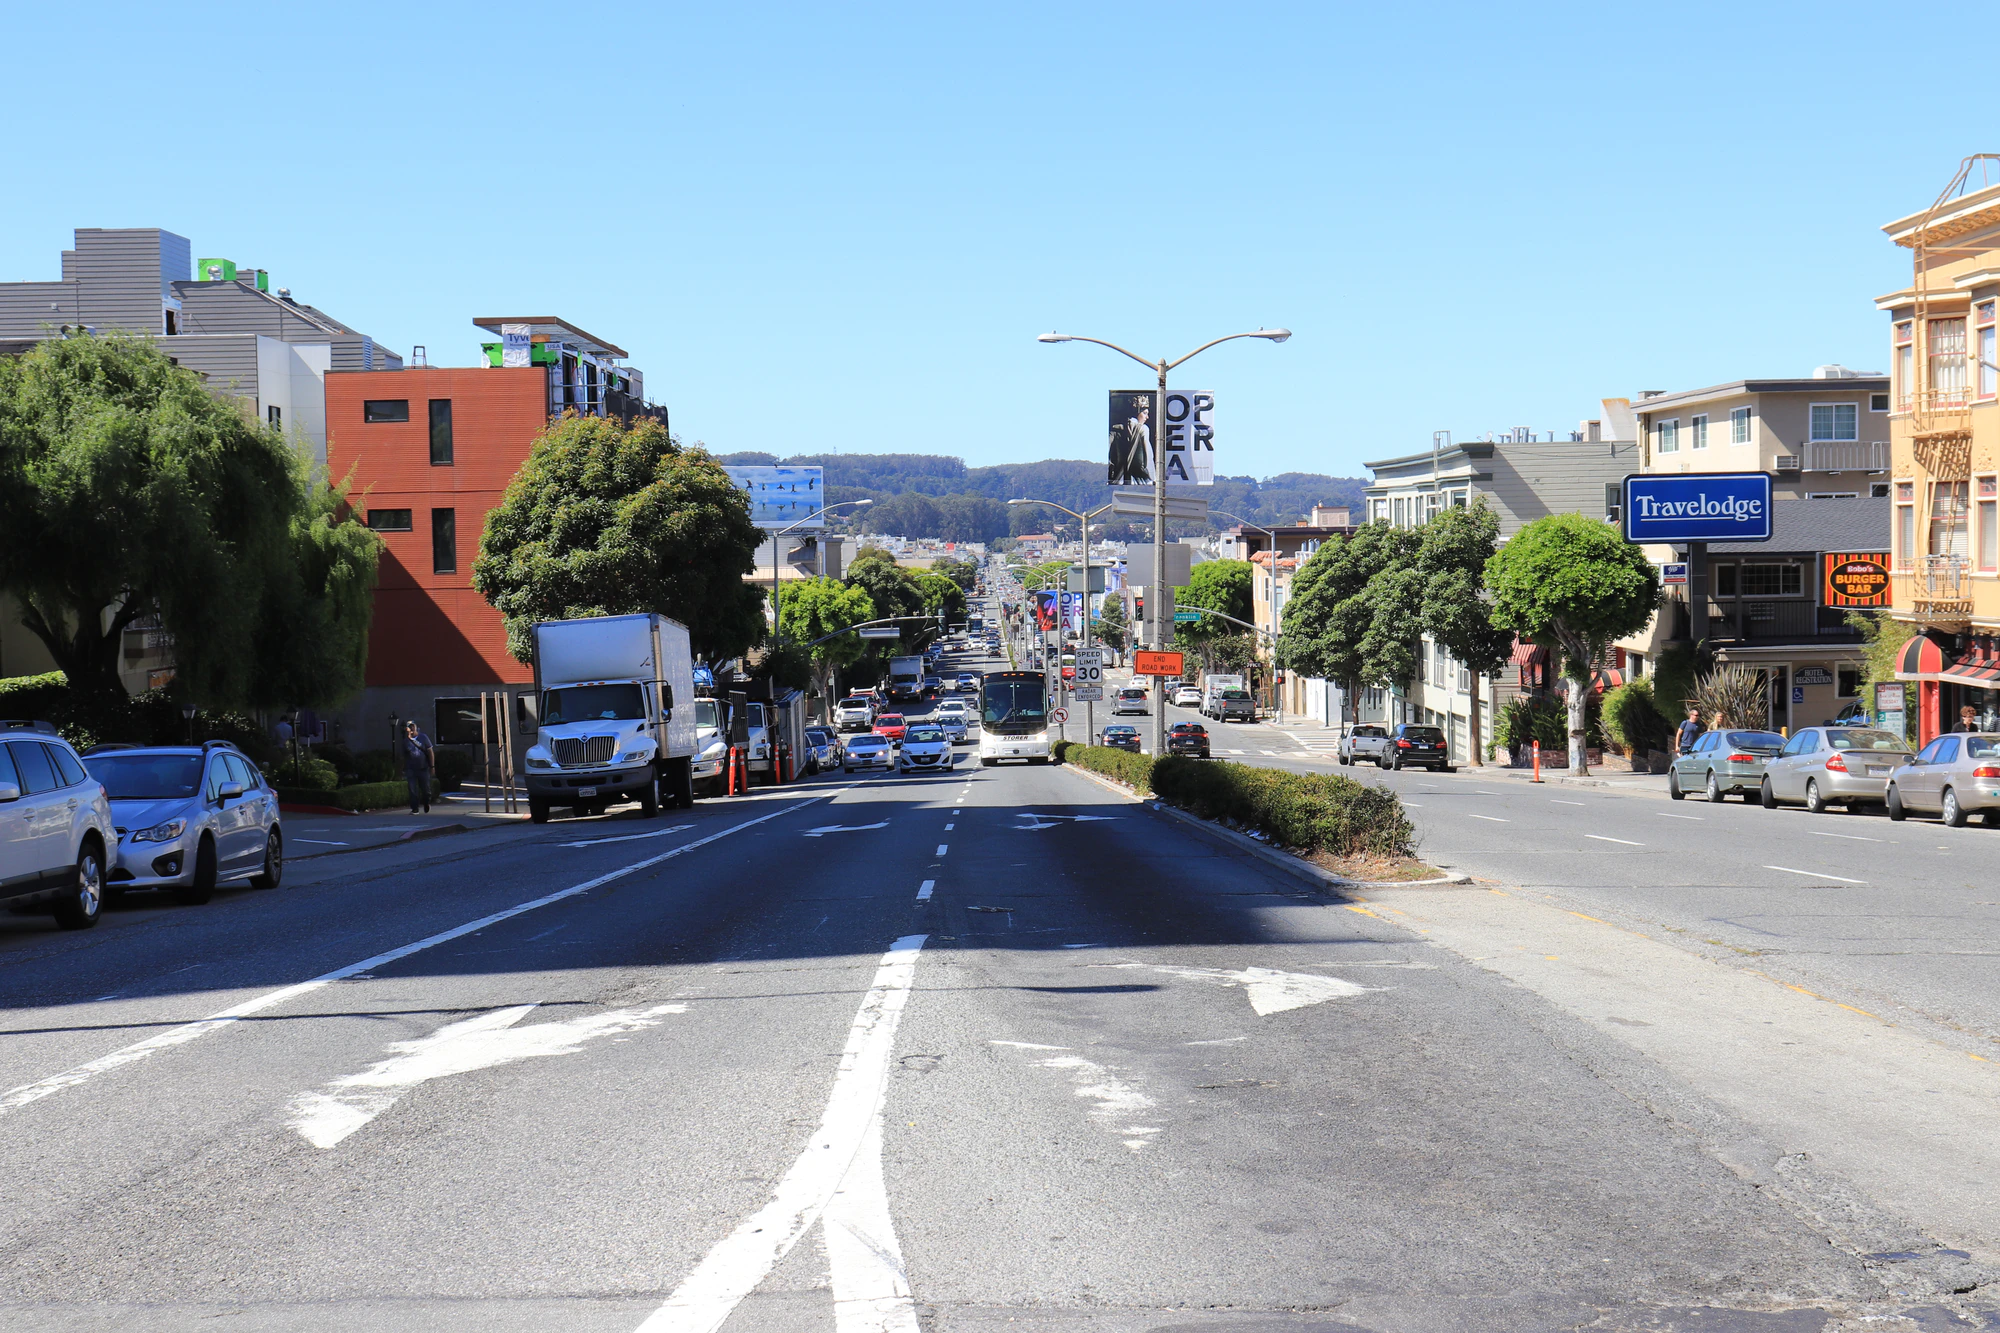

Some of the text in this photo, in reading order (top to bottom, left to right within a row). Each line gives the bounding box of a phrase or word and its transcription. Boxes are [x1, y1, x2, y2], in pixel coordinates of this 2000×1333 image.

[1635, 493, 1762, 522] Travelodge
[1846, 565, 1874, 573] Bobo's
[1835, 574, 1885, 584] BURGER
[1847, 584, 1873, 594] BAR
[1078, 667, 1100, 680] 30
[1804, 669, 1825, 677] HOTEL
[1796, 676, 1832, 684] REGISTRATION
[1878, 713, 1885, 721] 2
